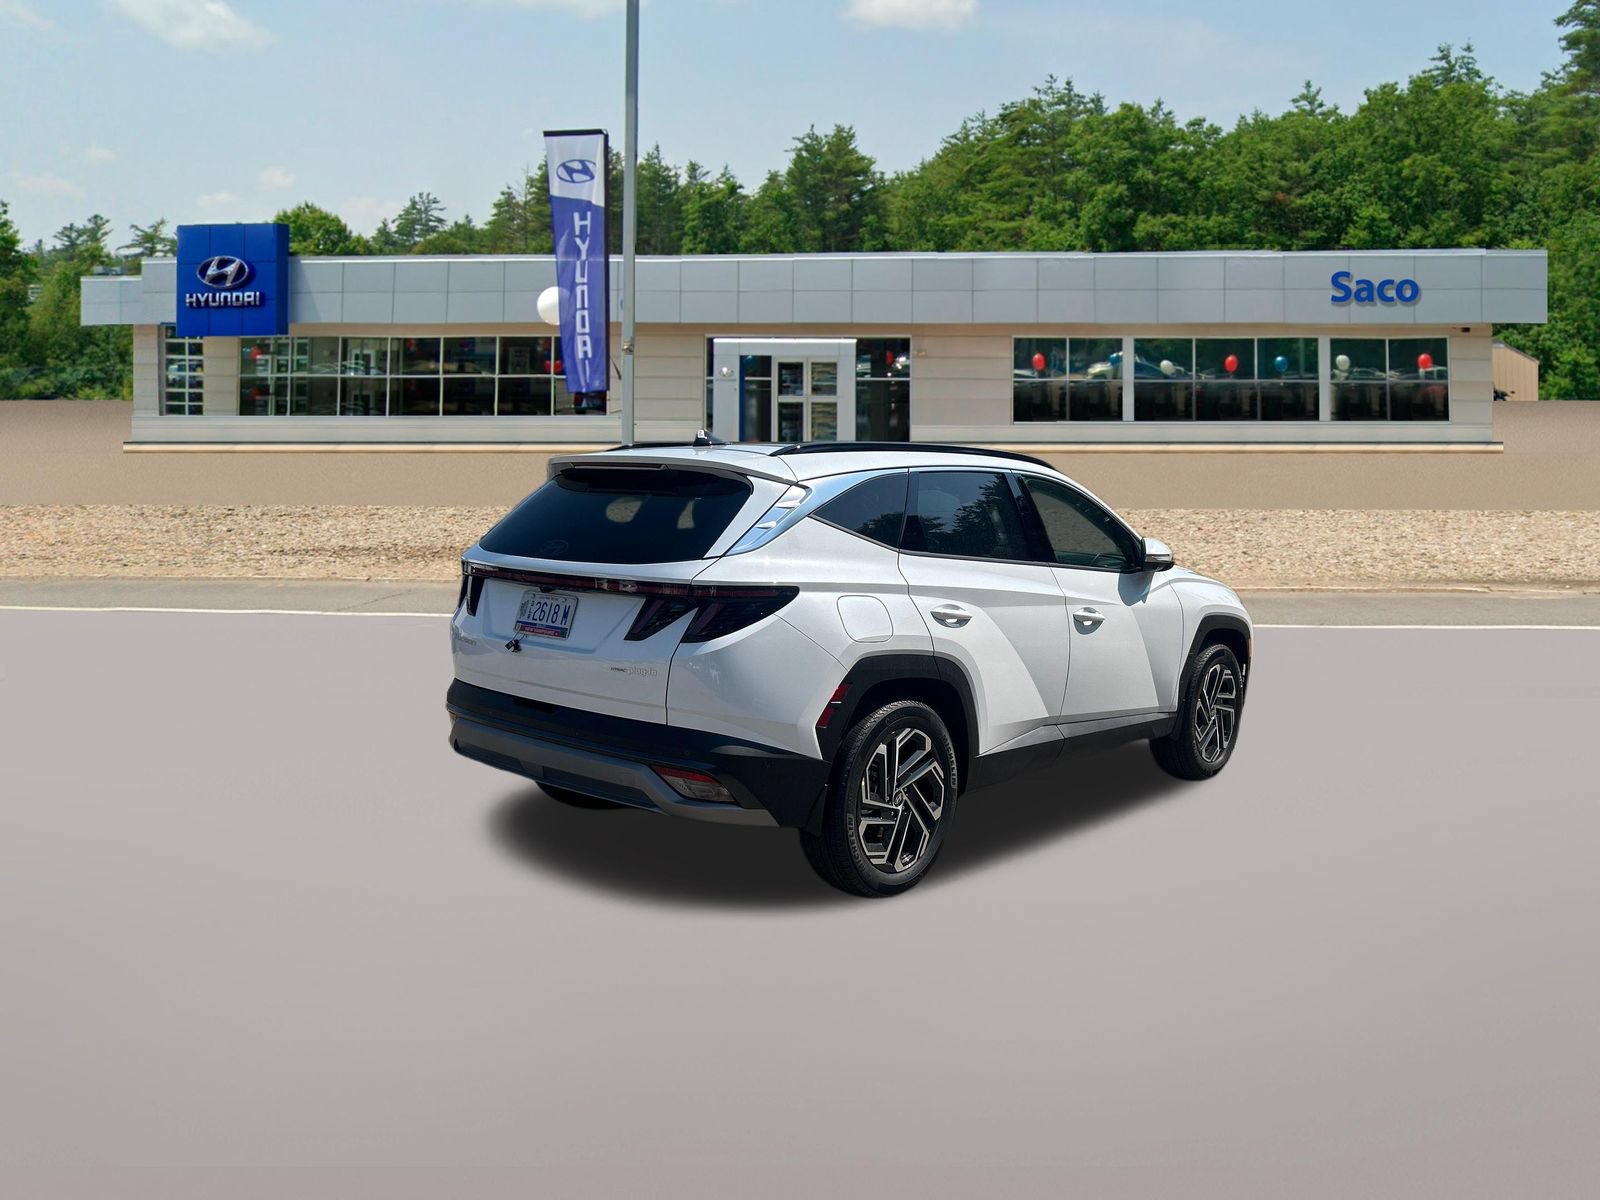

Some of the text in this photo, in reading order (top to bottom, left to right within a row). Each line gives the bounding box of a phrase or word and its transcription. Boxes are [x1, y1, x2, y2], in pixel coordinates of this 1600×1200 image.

[185, 291, 260, 307] HYUNDAI
[573, 211, 592, 383] HYUNDAI
[1330, 270, 1420, 303] Saco
[532, 601, 560, 624] 2618
